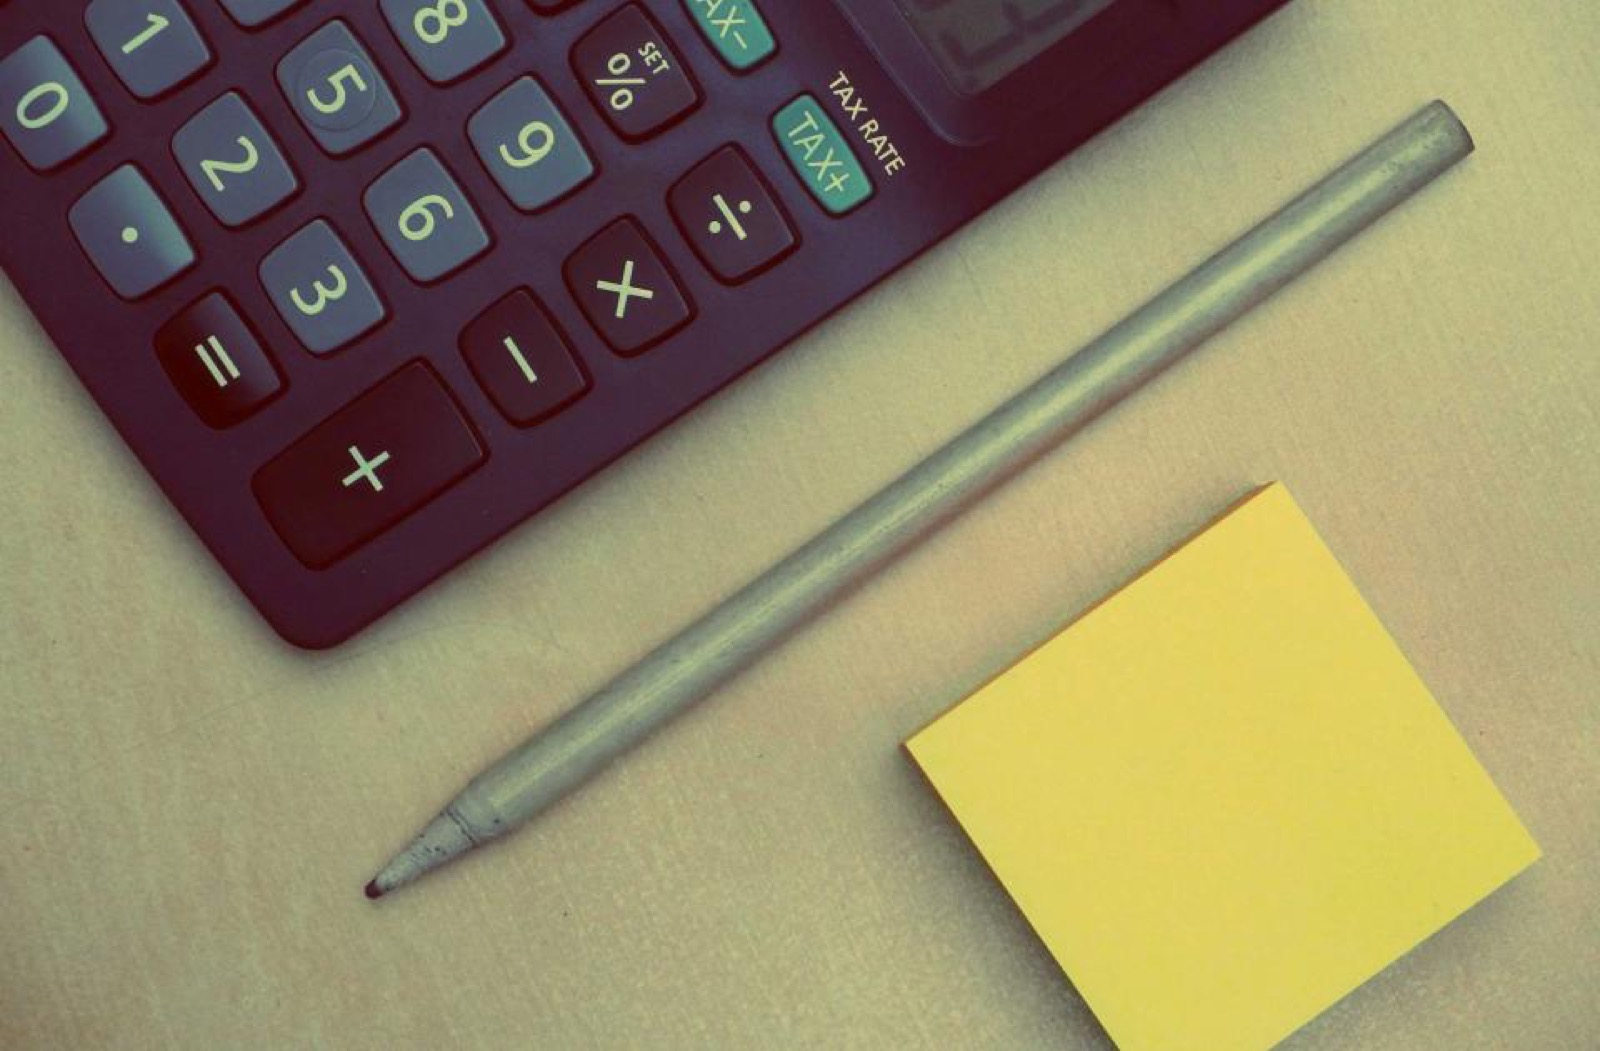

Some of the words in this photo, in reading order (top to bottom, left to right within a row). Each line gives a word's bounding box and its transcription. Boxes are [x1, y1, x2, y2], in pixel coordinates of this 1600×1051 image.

[122, 13, 169, 54] 1
[414, 0, 468, 43] 8
[638, 41, 670, 75] SET
[16, 82, 69, 129] 0
[307, 65, 367, 114] 5
[499, 120, 555, 168] 9
[829, 70, 868, 120] TAX
[858, 118, 906, 176] RATE
[200, 135, 259, 192] 2
[788, 110, 850, 192] TAX+
[398, 194, 454, 241] 6
[290, 264, 348, 315] 3
